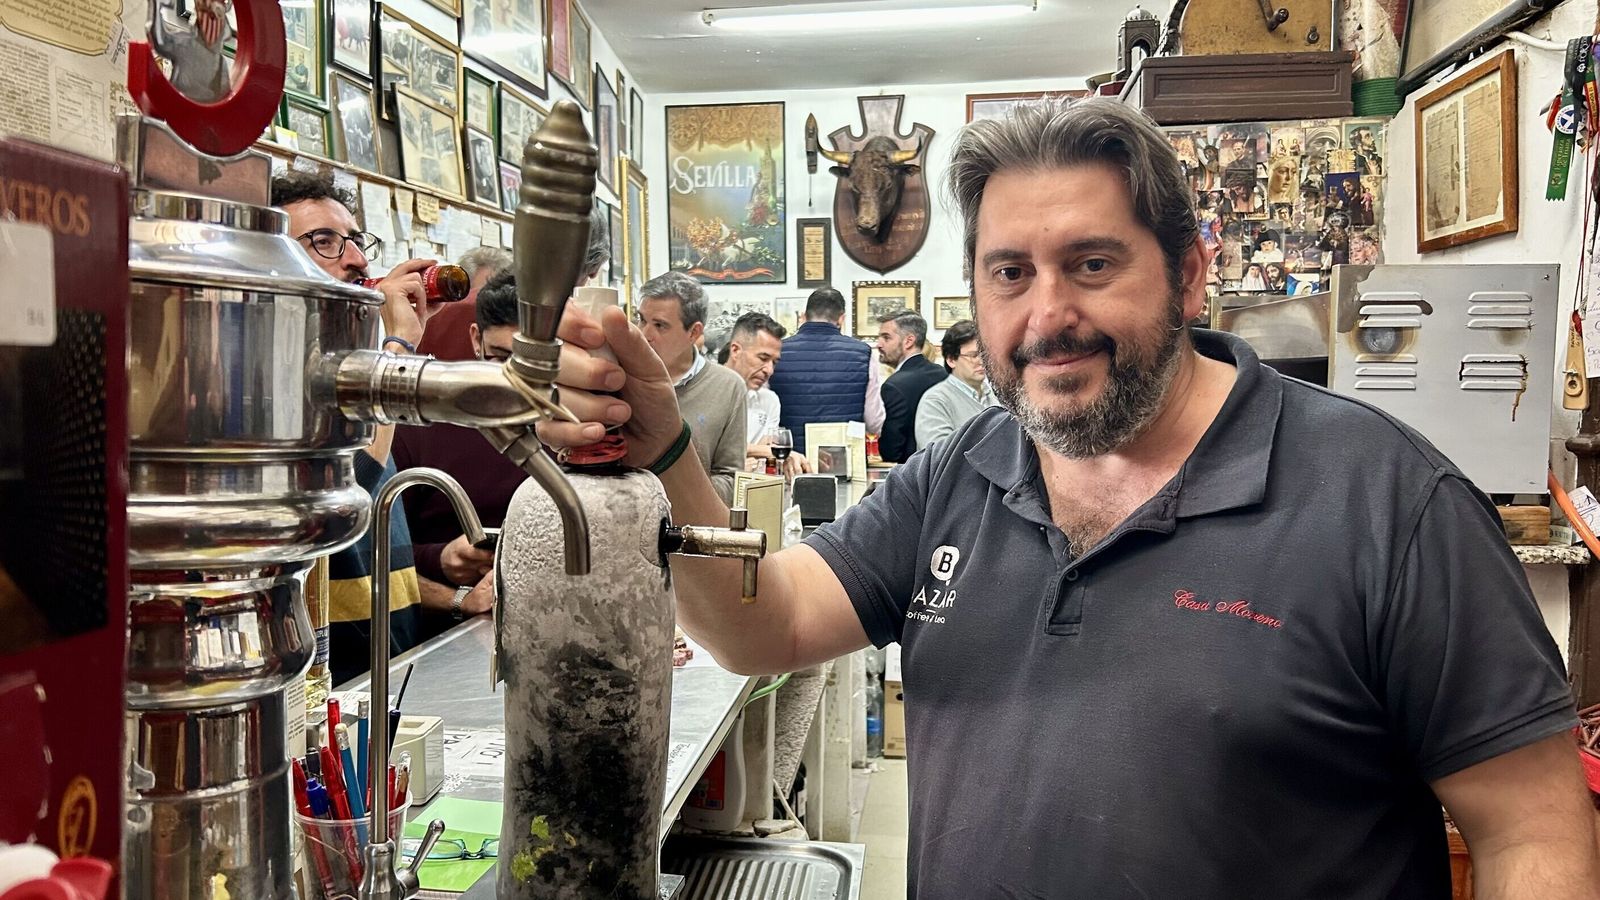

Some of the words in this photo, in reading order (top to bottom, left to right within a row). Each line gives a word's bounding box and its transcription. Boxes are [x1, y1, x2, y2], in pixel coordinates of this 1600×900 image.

[937, 551, 953, 574] B
[910, 585, 957, 609] AZAR
[1174, 589, 1211, 611] Casa
[1215, 599, 1284, 630] Moreno
